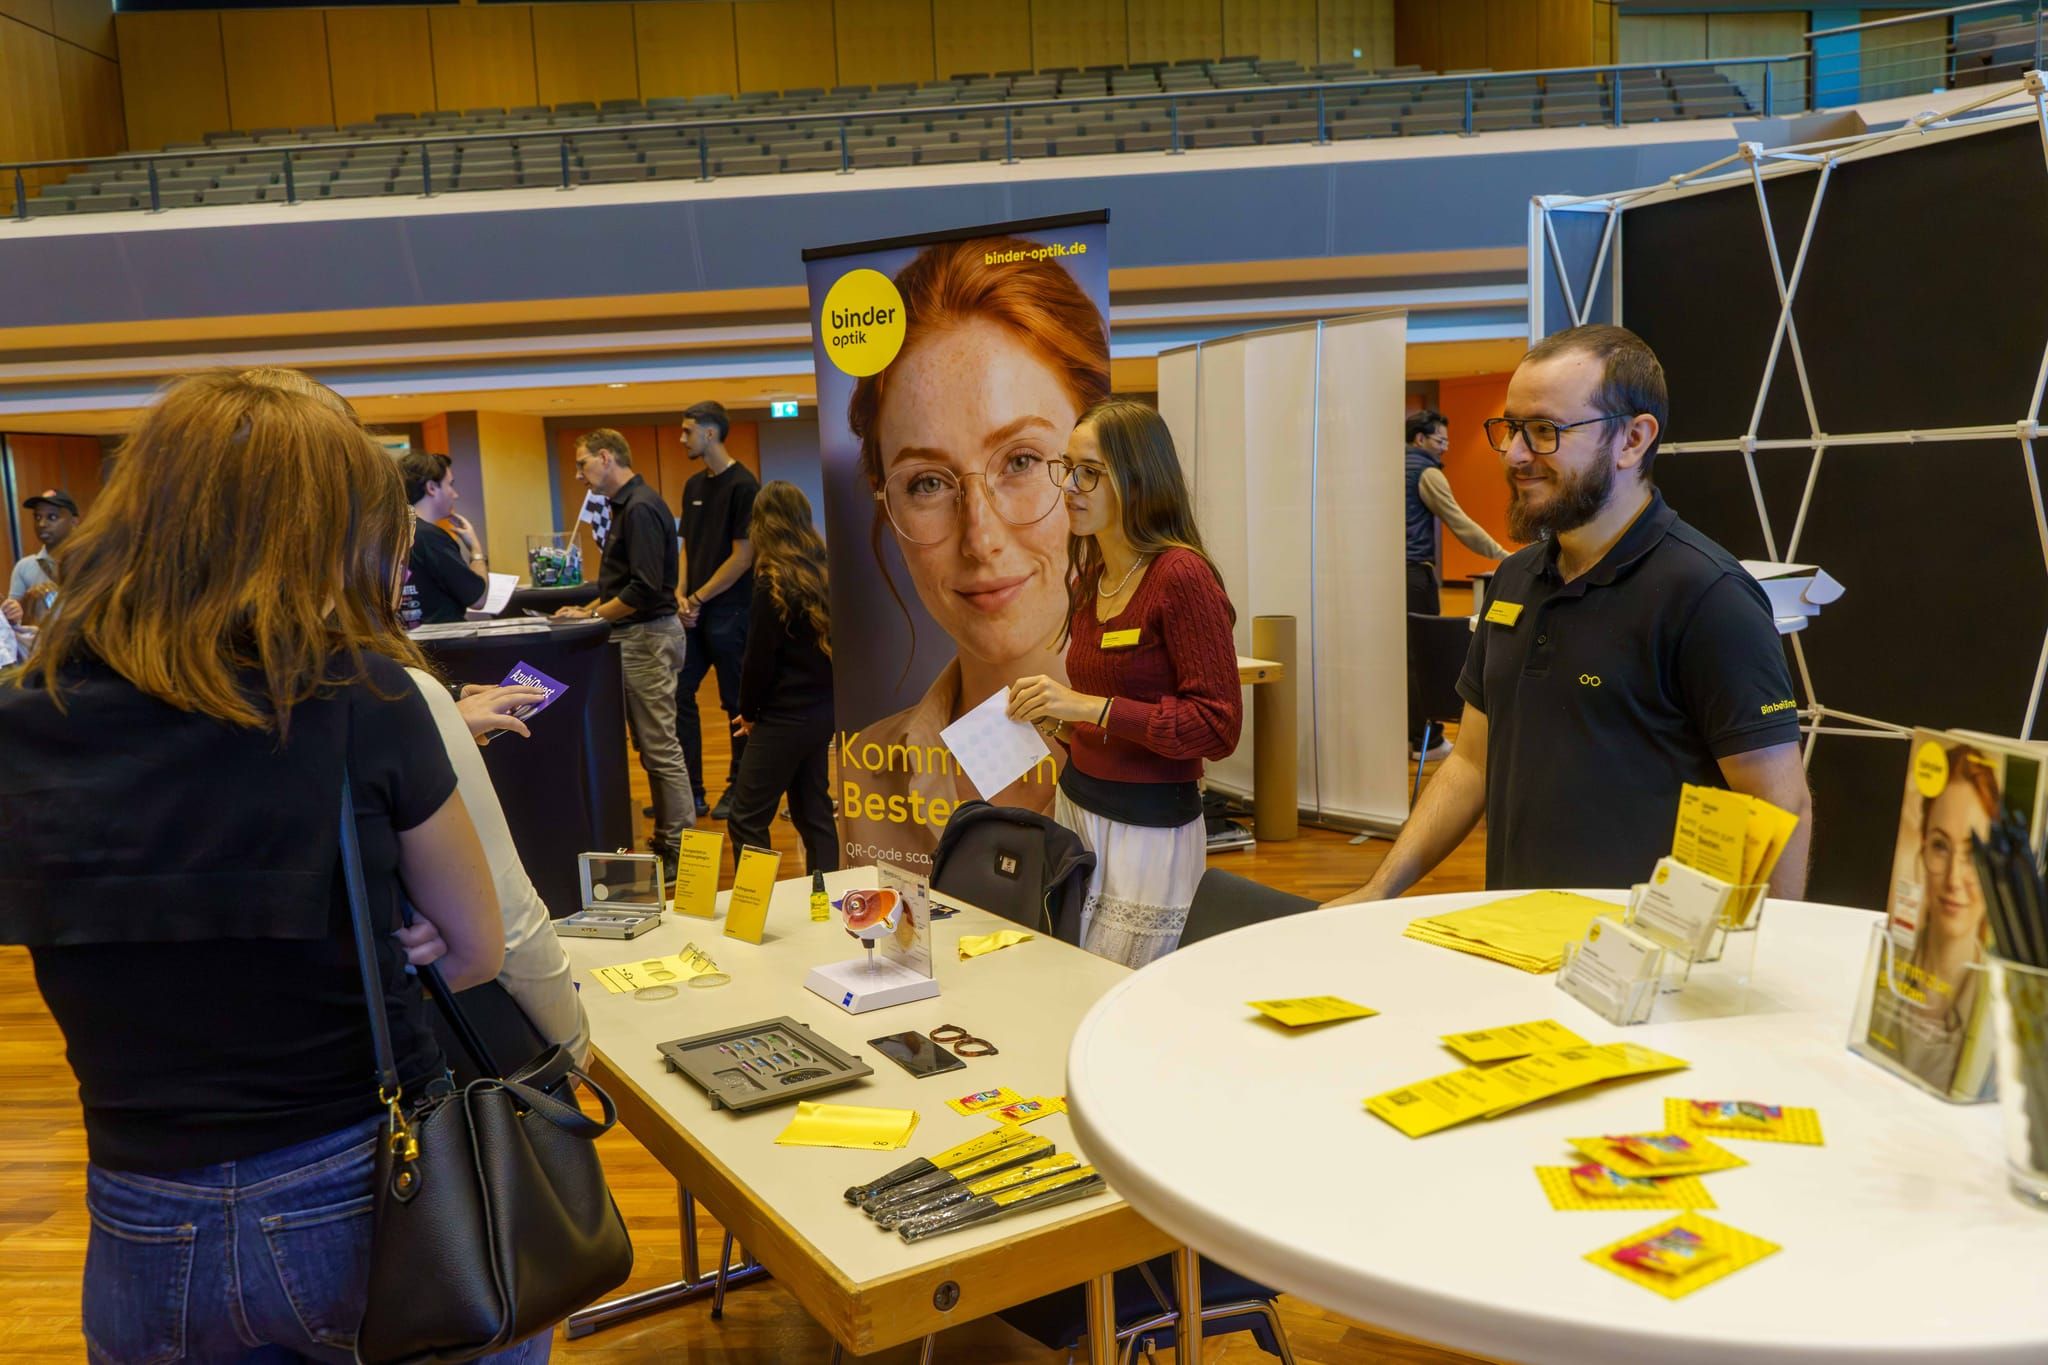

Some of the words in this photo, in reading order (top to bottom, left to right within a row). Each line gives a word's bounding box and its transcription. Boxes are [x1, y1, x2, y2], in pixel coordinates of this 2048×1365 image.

[984, 241, 1087, 265] binder-optik.de
[831, 305, 896, 329] binder
[832, 330, 867, 348] optik
[841, 731, 961, 776] Komm
[843, 781, 967, 826] Beste
[846, 842, 902, 860] QR-Code
[905, 850, 933, 864] sca
